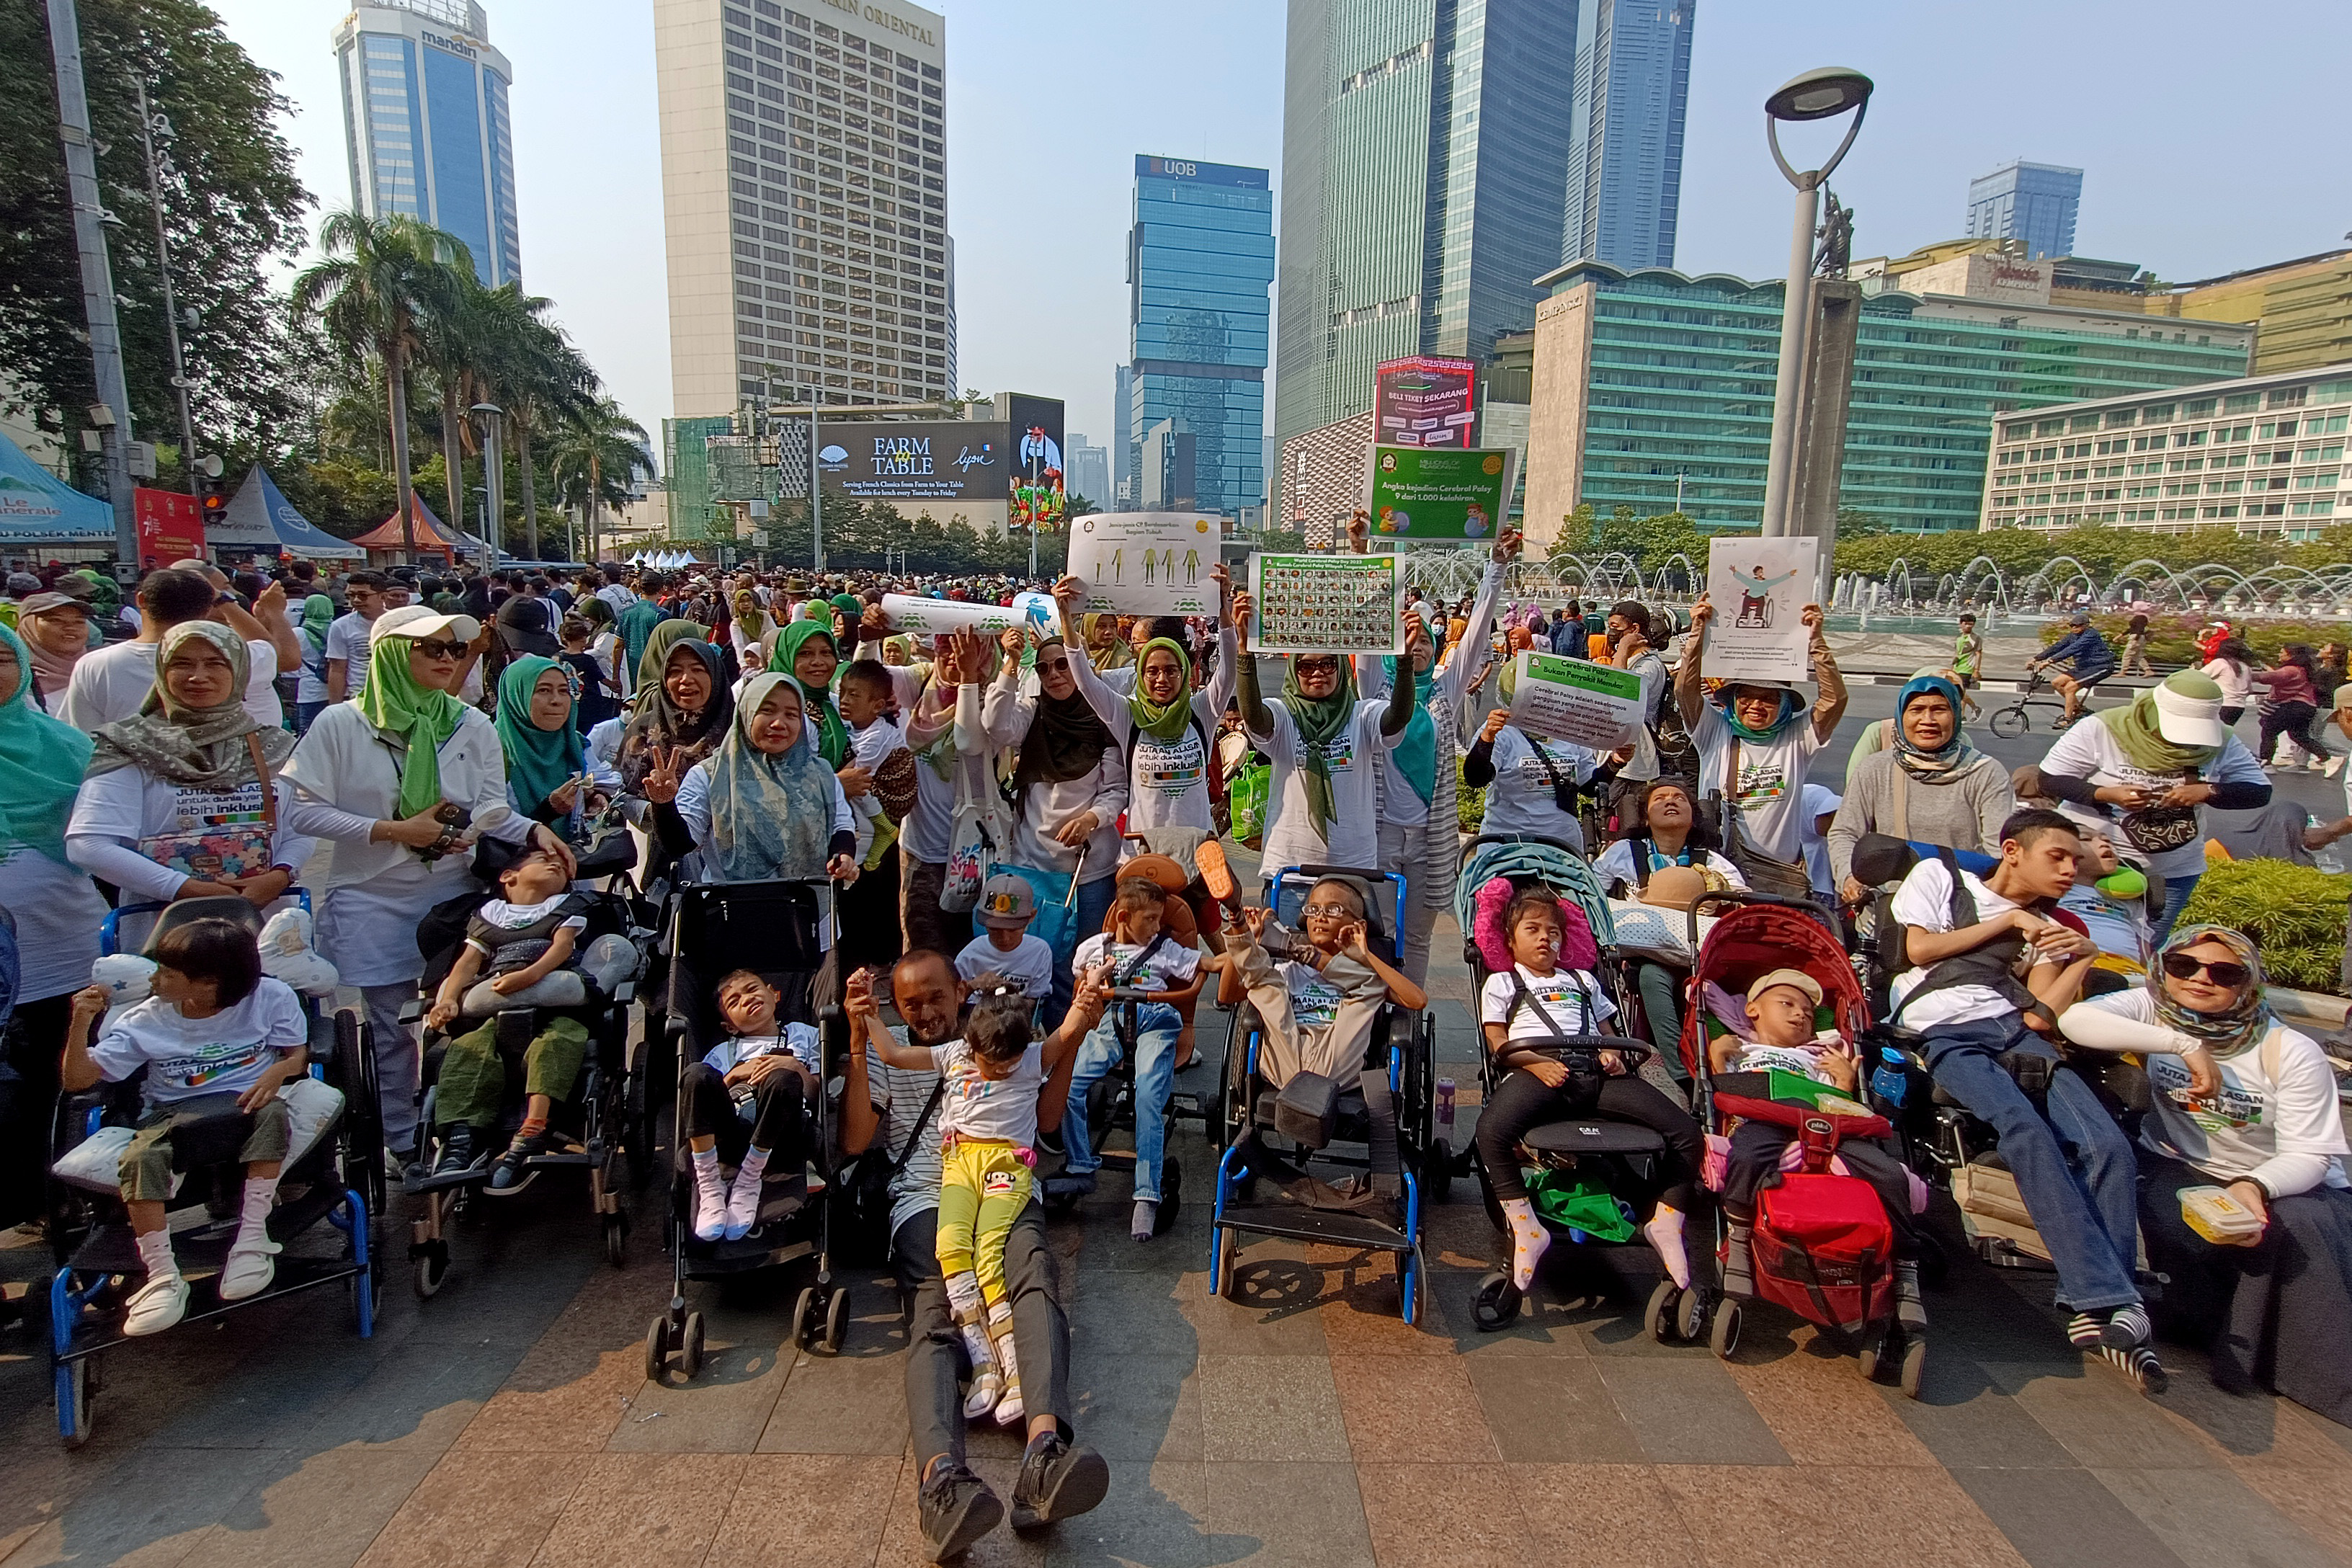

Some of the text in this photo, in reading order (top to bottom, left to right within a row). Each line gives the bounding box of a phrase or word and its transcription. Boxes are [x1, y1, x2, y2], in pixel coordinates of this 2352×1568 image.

[864, 6, 935, 48] ORIENTAL
[1164, 160, 1197, 177] UOB
[1538, 295, 1584, 323] KEMPINSKI
[1389, 388, 1469, 404] BELI TIKET SEKARANG
[873, 437, 930, 455] FARM
[894, 450, 911, 463] to
[951, 446, 995, 473] lyon
[870, 457, 935, 476] TABLE
[1382, 482, 1405, 491] Angka
[1407, 484, 1438, 493] kejadian
[1472, 485, 1492, 494] Palsy
[4, 496, 28, 507] Le
[1561, 659, 1610, 678] Cerebral Palsy
[1543, 666, 1624, 690] Bukan Penyakit Menular
[1532, 694, 1561, 705] gangguan
[1561, 700, 1575, 709] yang
[1534, 685, 1627, 712] Cerebral Palsy adalah sekelompok
[1566, 709, 1582, 718] tonus
[1582, 712, 1594, 721] otot
[1607, 718, 1626, 728] postur
[1139, 758, 1200, 771] lebih inklusif
[177, 796, 210, 805] untuk
[213, 793, 242, 803] dunia
[177, 805, 213, 816] lebih
